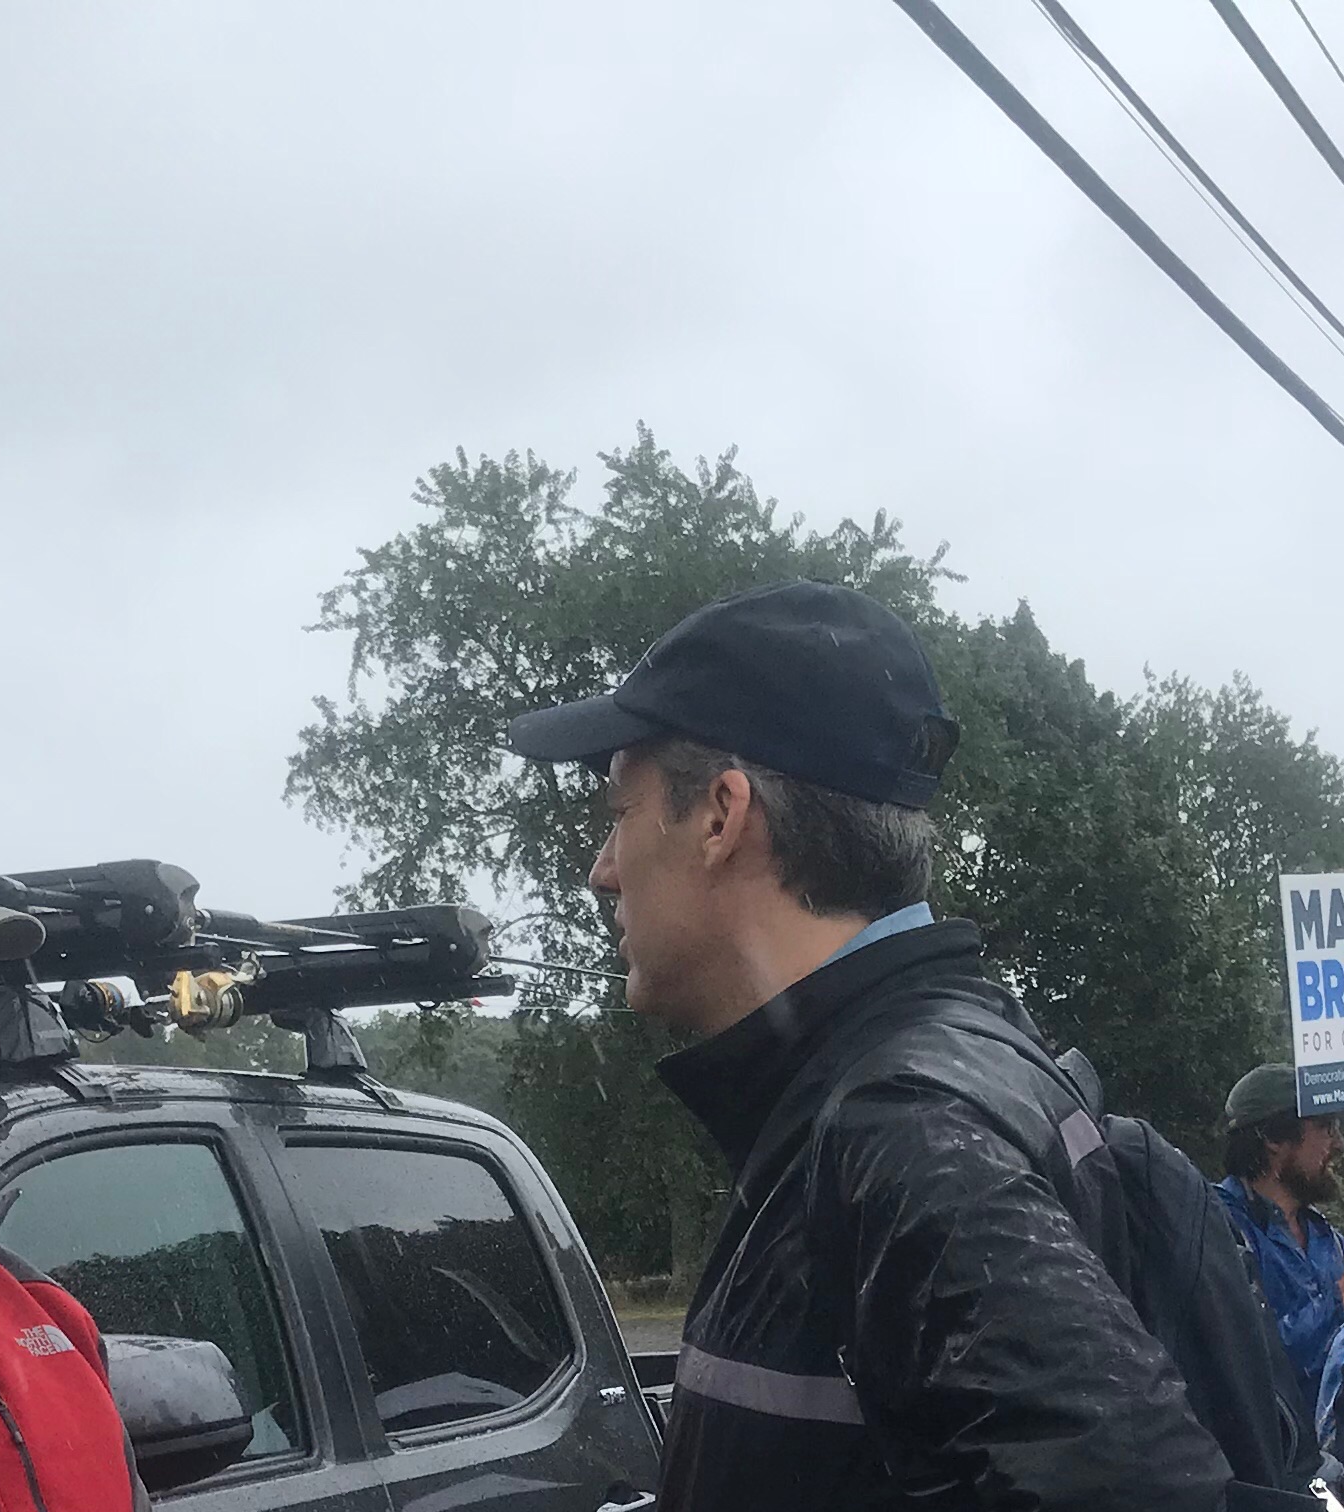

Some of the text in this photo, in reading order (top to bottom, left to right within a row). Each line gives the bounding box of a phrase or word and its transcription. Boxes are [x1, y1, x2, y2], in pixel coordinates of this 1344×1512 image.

[1302, 1030, 1333, 1053] FOR
[20, 1325, 45, 1339] THE
[14, 1333, 51, 1348] NORTH
[27, 1344, 57, 1357] FACE
